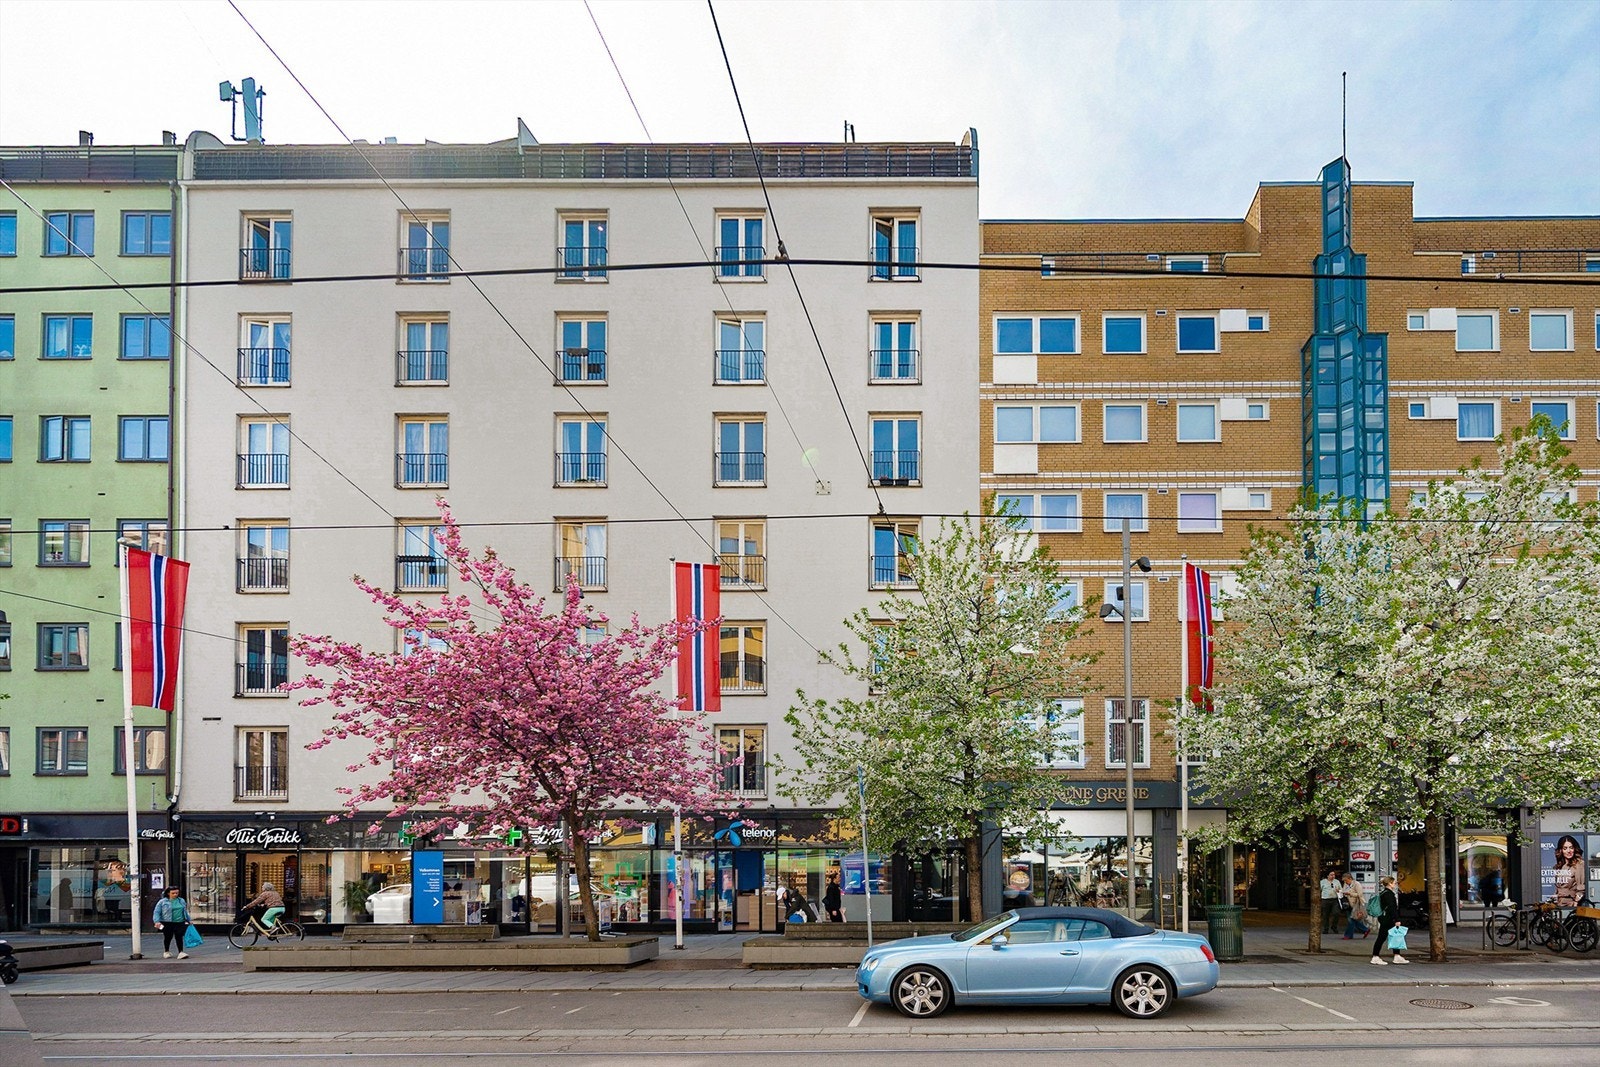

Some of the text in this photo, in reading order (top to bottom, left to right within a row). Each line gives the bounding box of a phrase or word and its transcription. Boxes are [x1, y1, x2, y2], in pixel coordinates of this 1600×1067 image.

[1096, 787, 1150, 803] GRENE
[226, 827, 302, 849] Ollis Optikk
[742, 828, 776, 837] telenor
